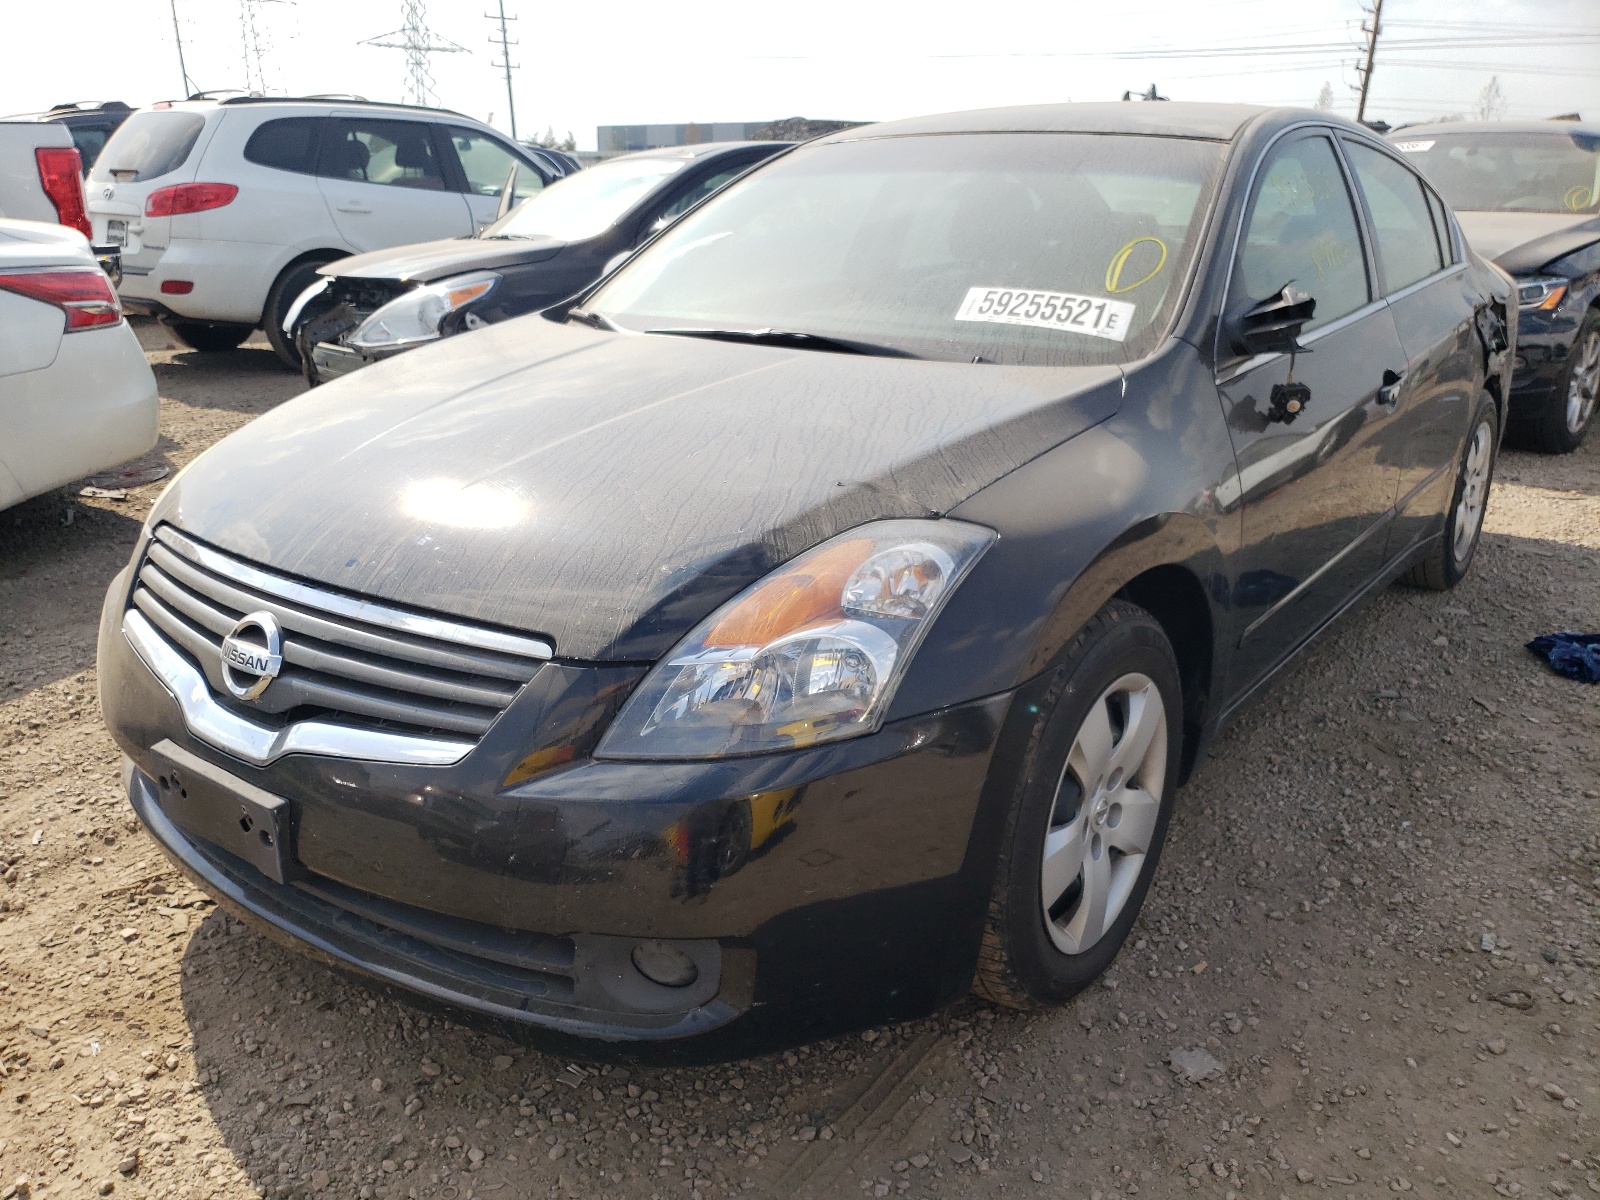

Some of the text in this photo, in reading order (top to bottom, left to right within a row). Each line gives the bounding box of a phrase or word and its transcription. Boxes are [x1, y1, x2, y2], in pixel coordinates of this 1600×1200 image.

[978, 291, 1107, 328] 59255521
[1107, 313, 1119, 329] E
[222, 645, 268, 671] NISSAN
